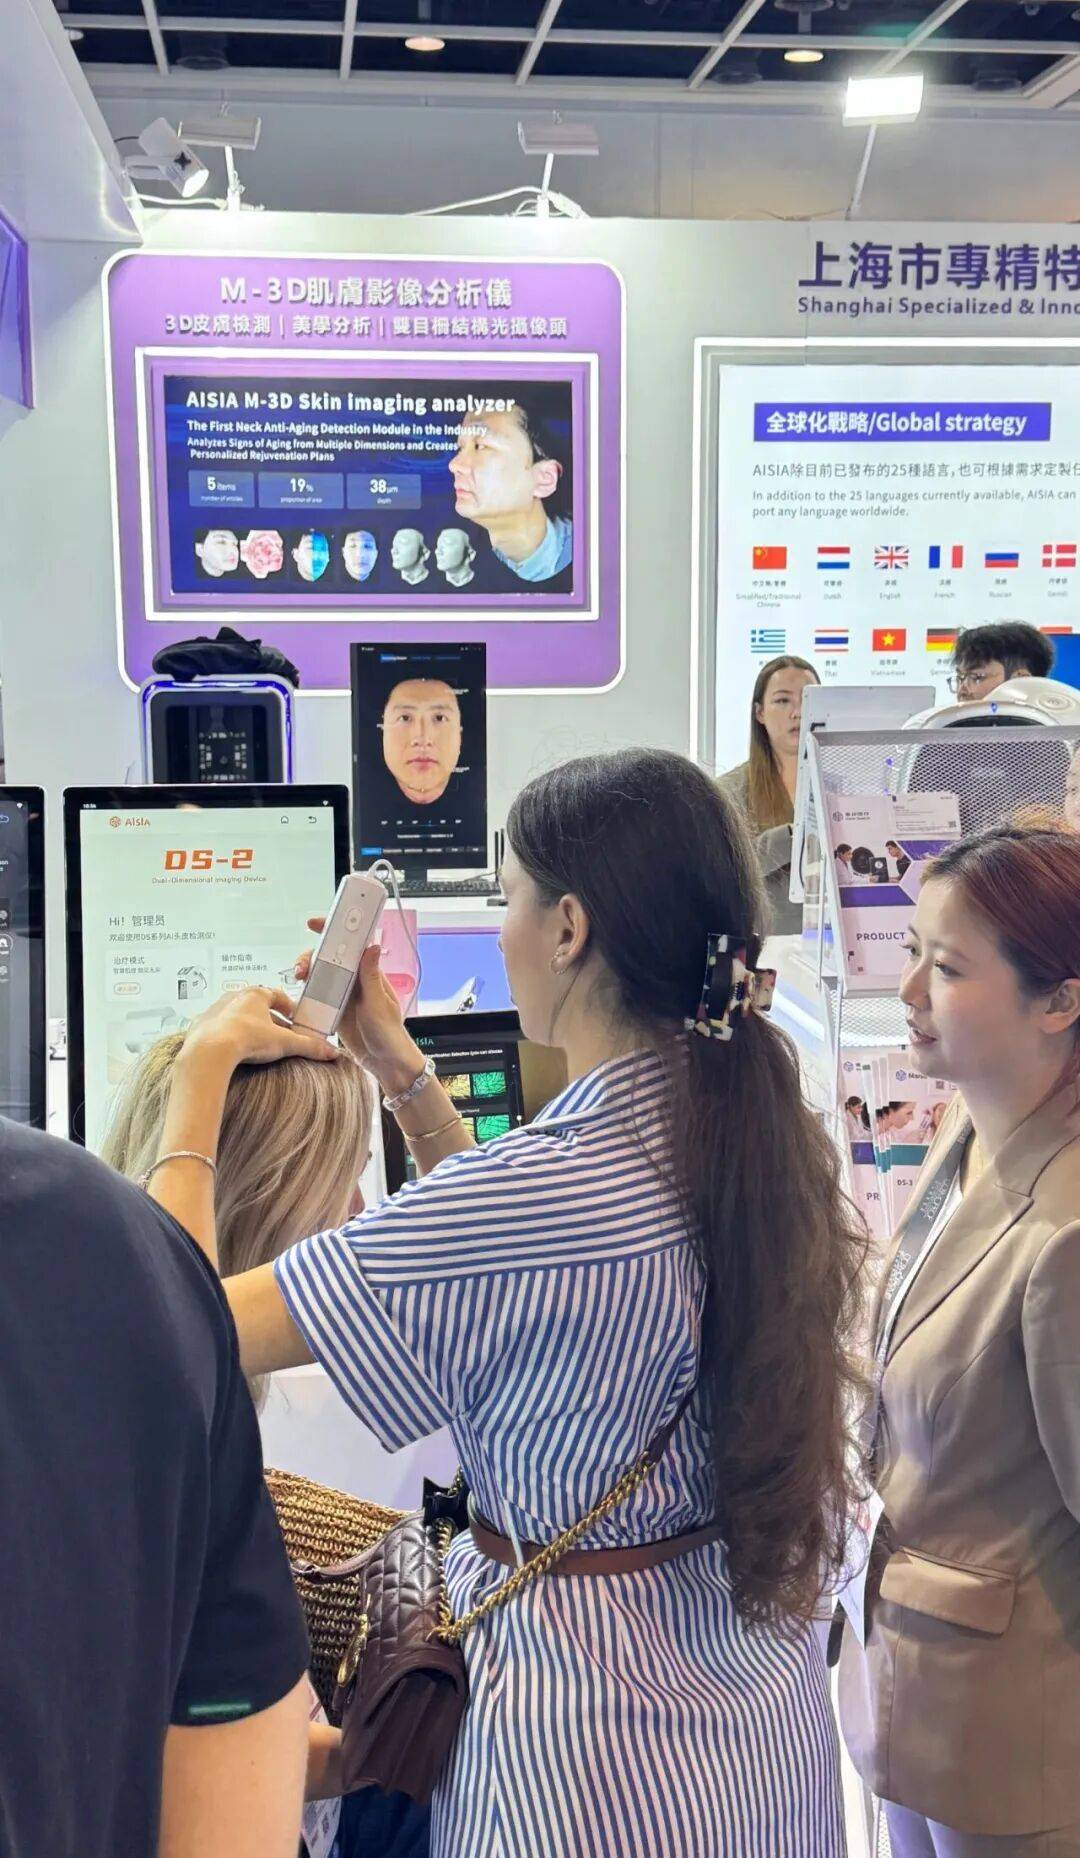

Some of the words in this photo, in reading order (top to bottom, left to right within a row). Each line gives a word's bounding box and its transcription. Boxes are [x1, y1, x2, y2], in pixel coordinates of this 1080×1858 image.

[798, 241, 1080, 291] 上海市專精特
[798, 296, 893, 318] Shanghai
[898, 297, 1012, 318] Specialized
[1019, 299, 1034, 314] &
[292, 316, 371, 337] 美學分析
[186, 391, 239, 408] AISIA
[244, 392, 293, 409] M-3D
[299, 392, 342, 410] Skin
[432, 394, 516, 415] analyzer
[187, 420, 208, 431] The
[209, 421, 234, 432] First
[236, 422, 262, 433] Neck
[264, 422, 319, 435] Anti-Aging
[320, 423, 371, 434] Detection
[372, 424, 411, 436] Module
[412, 424, 423, 435] in
[424, 424, 442, 435] the
[444, 425, 487, 437] Industry
[945, 412, 1027, 436] strategy
[187, 437, 227, 449] Analyzes
[229, 438, 253, 449] Signs
[255, 438, 265, 447] of
[266, 439, 292, 450] Aging
[293, 439, 314, 449] from
[316, 440, 353, 451] Multiple
[354, 441, 405, 451] Dimensions
[407, 441, 424, 450] and
[425, 442, 458, 451] Creates
[190, 449, 249, 461] Personalized
[250, 450, 309, 462] Rejuvenation
[310, 451, 335, 462] Plans
[207, 476, 217, 491] 5
[753, 490, 763, 501] In
[766, 490, 811, 501] addition
[815, 491, 826, 501] to
[829, 490, 847, 501] the
[850, 491, 862, 501] 25
[865, 490, 919, 503] languages
[922, 490, 970, 503] currently
[973, 490, 1025, 501] available,
[1027, 490, 1054, 500] AISIA
[1057, 491, 1076, 500] can
[752, 507, 775, 518] port
[778, 508, 796, 519] any
[800, 506, 847, 518] language
[851, 506, 909, 517] worldwide.
[164, 849, 254, 871] DS-2
[856, 932, 906, 941] PRODUCT
